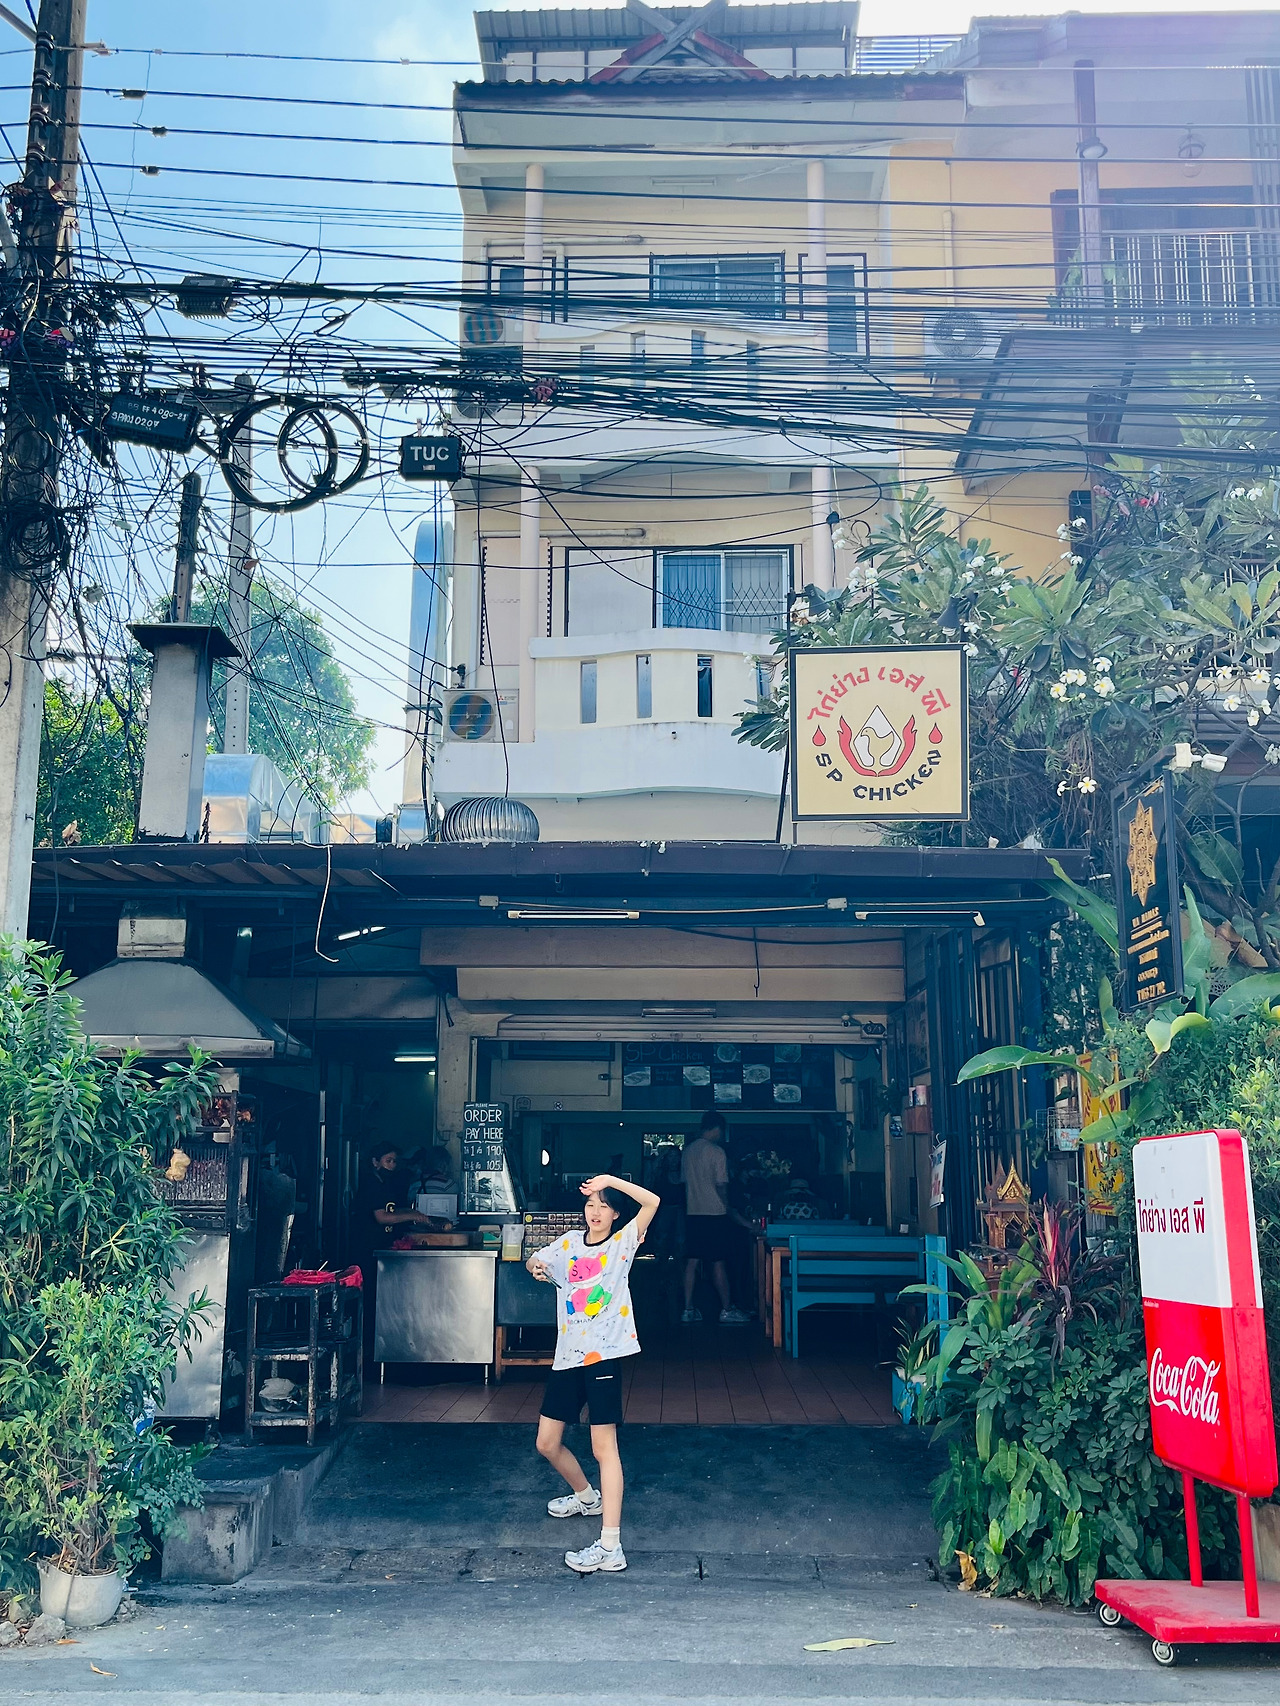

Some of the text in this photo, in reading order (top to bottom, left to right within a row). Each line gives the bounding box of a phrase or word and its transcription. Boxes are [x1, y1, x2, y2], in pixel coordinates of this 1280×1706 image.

[410, 446, 450, 461] TUC
[807, 666, 951, 720] ไก่ย่าง เอส พี
[815, 749, 942, 801] SP CHICKEN
[626, 1043, 703, 1062] SP Chicken
[464, 1109, 502, 1122] ORDER
[465, 1127, 503, 1139] PAY HERE
[1137, 1197, 1205, 1233] ไก่ย่าง เอส พี
[1150, 1347, 1221, 1424] Coca-Cola
